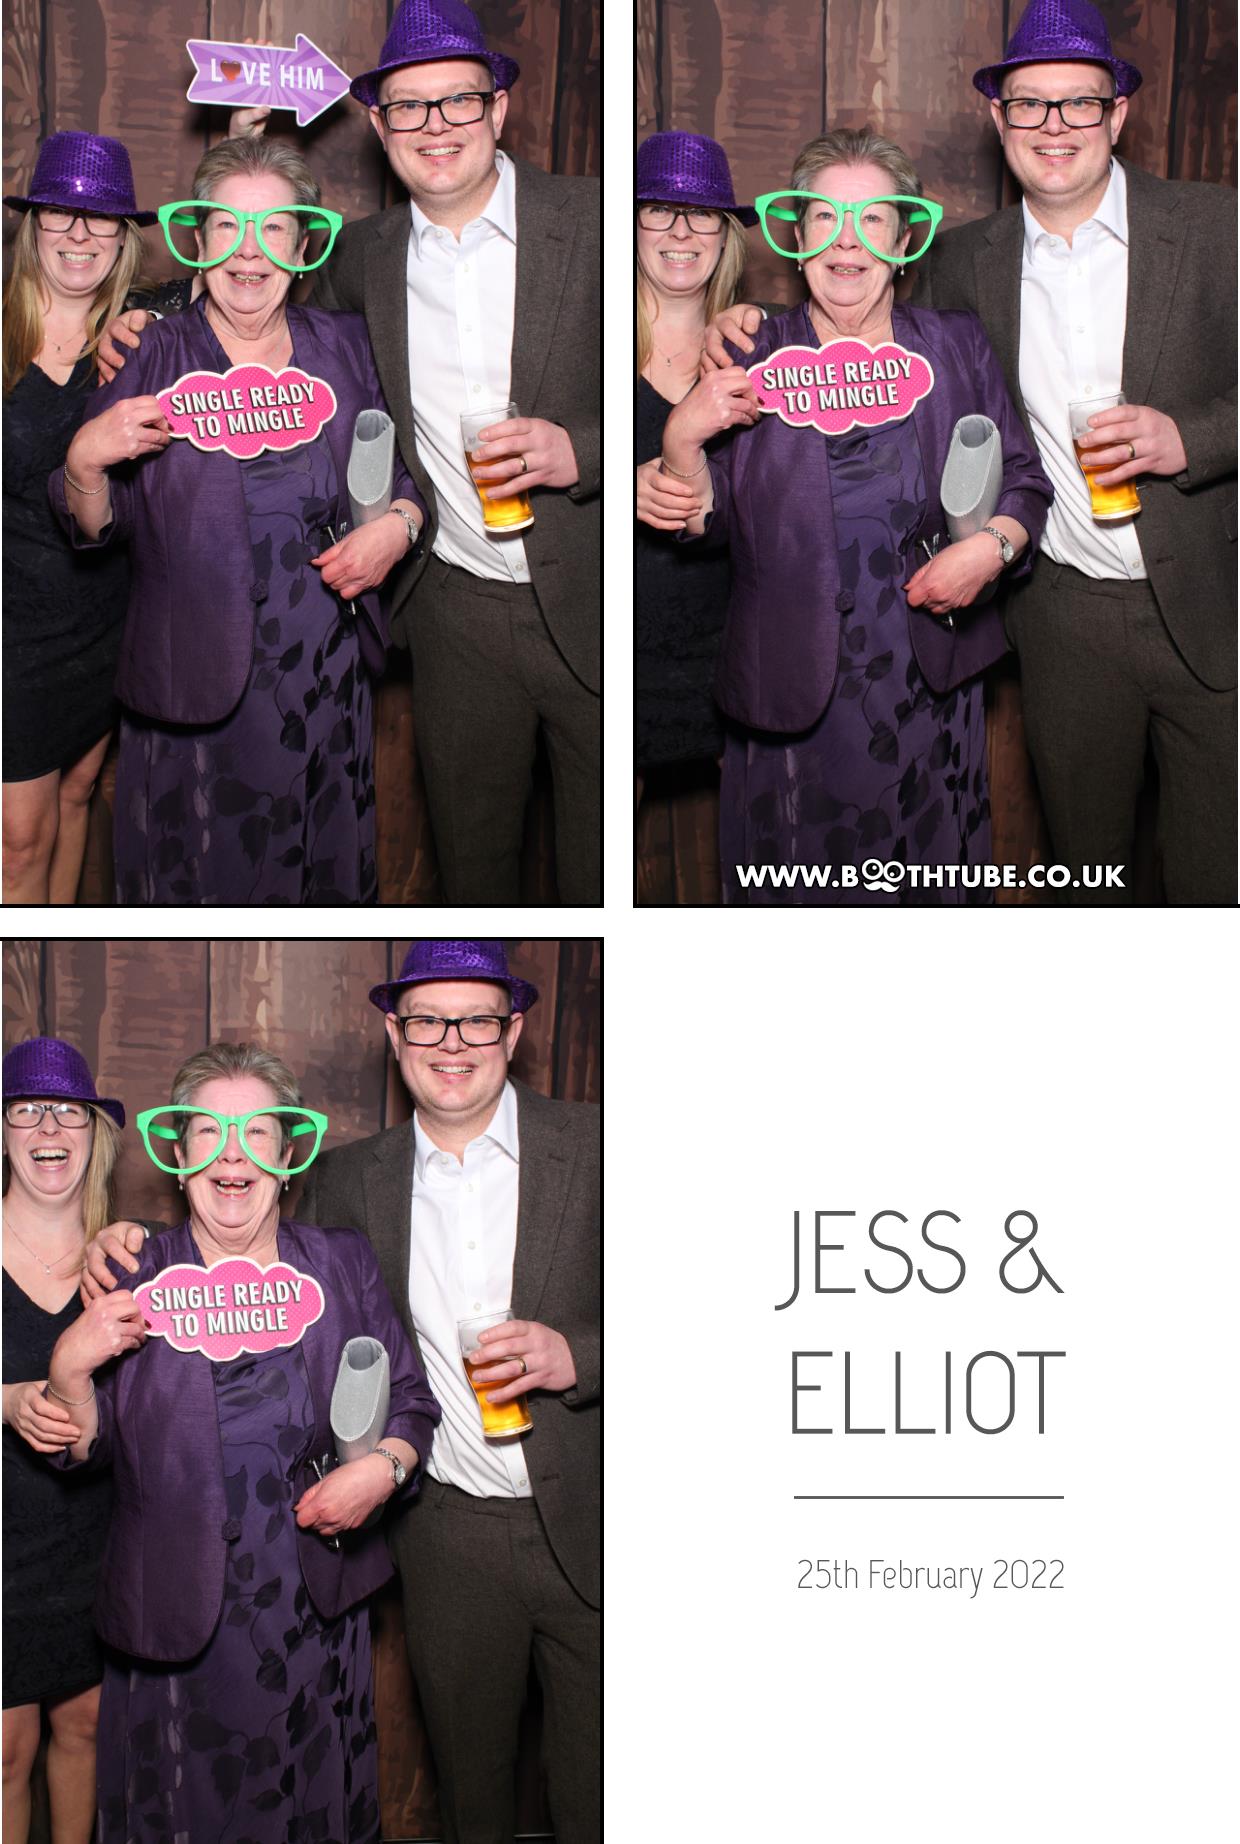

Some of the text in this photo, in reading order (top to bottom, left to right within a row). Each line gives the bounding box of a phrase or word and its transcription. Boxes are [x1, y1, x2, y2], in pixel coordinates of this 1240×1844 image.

[280, 64, 324, 91] HIM
[763, 358, 912, 390] SINGLE READY
[171, 382, 315, 415] SINGLE READY
[784, 384, 899, 413] TO MINGLE
[194, 408, 305, 438] TO MINGLE
[150, 1280, 302, 1311] SINGLE READY
[172, 1308, 288, 1337] TO MINGLE
